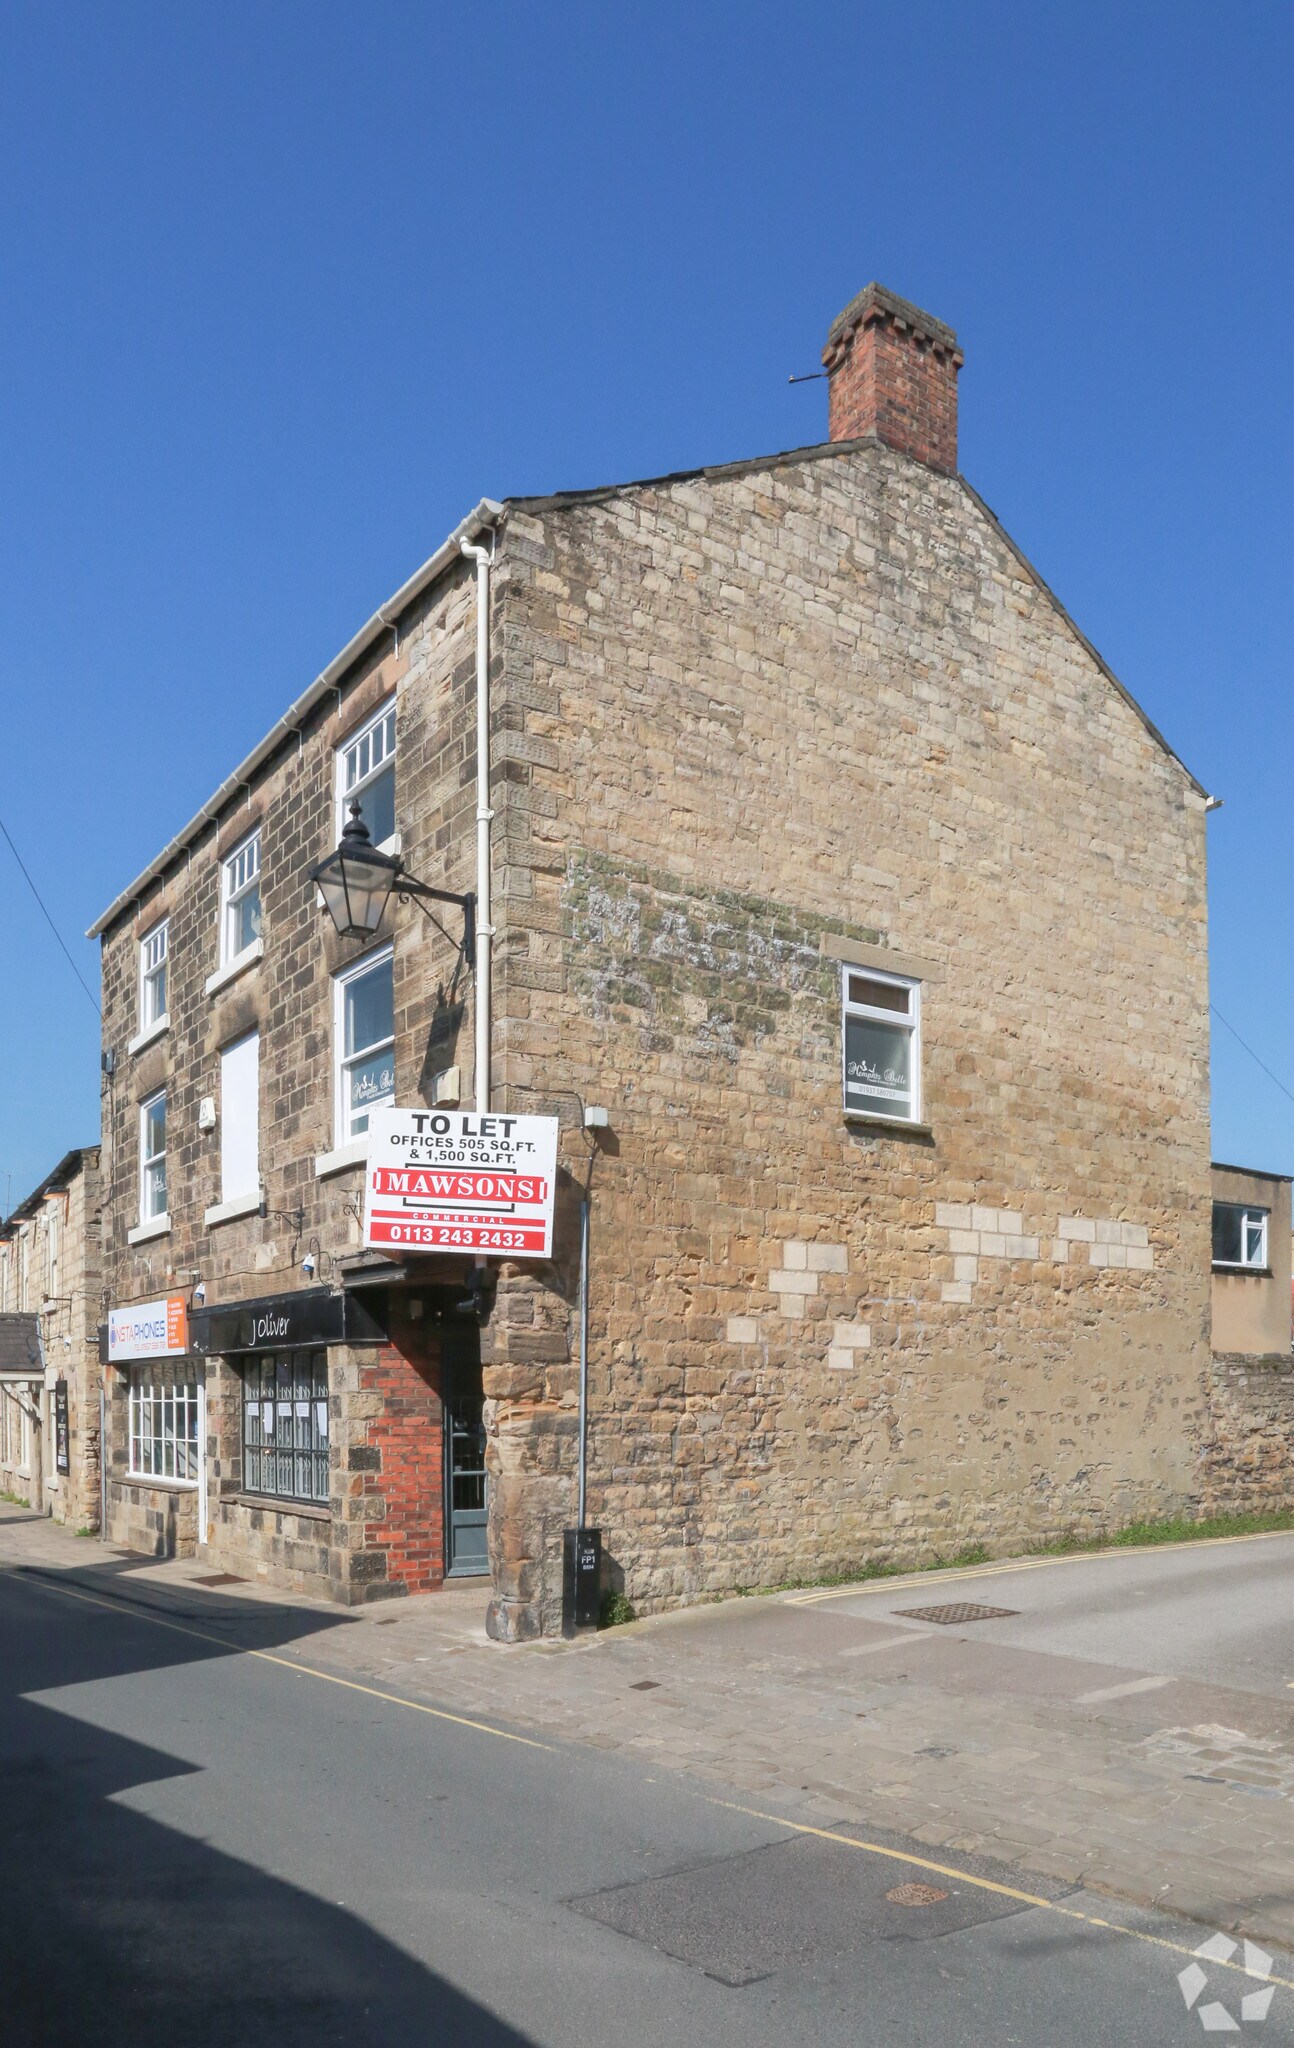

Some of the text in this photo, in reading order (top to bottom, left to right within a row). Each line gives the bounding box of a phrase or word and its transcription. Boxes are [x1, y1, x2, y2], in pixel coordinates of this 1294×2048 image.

[411, 1113, 517, 1138] TO LET
[390, 1134, 537, 1153] OFFICES 505 SQ.FT.
[409, 1148, 516, 1164] & 1,500 SQ.FT.
[387, 1172, 535, 1199] MAWSONS
[412, 1212, 505, 1224] COMMERCIAL
[390, 1225, 525, 1247] 0113 243 2432
